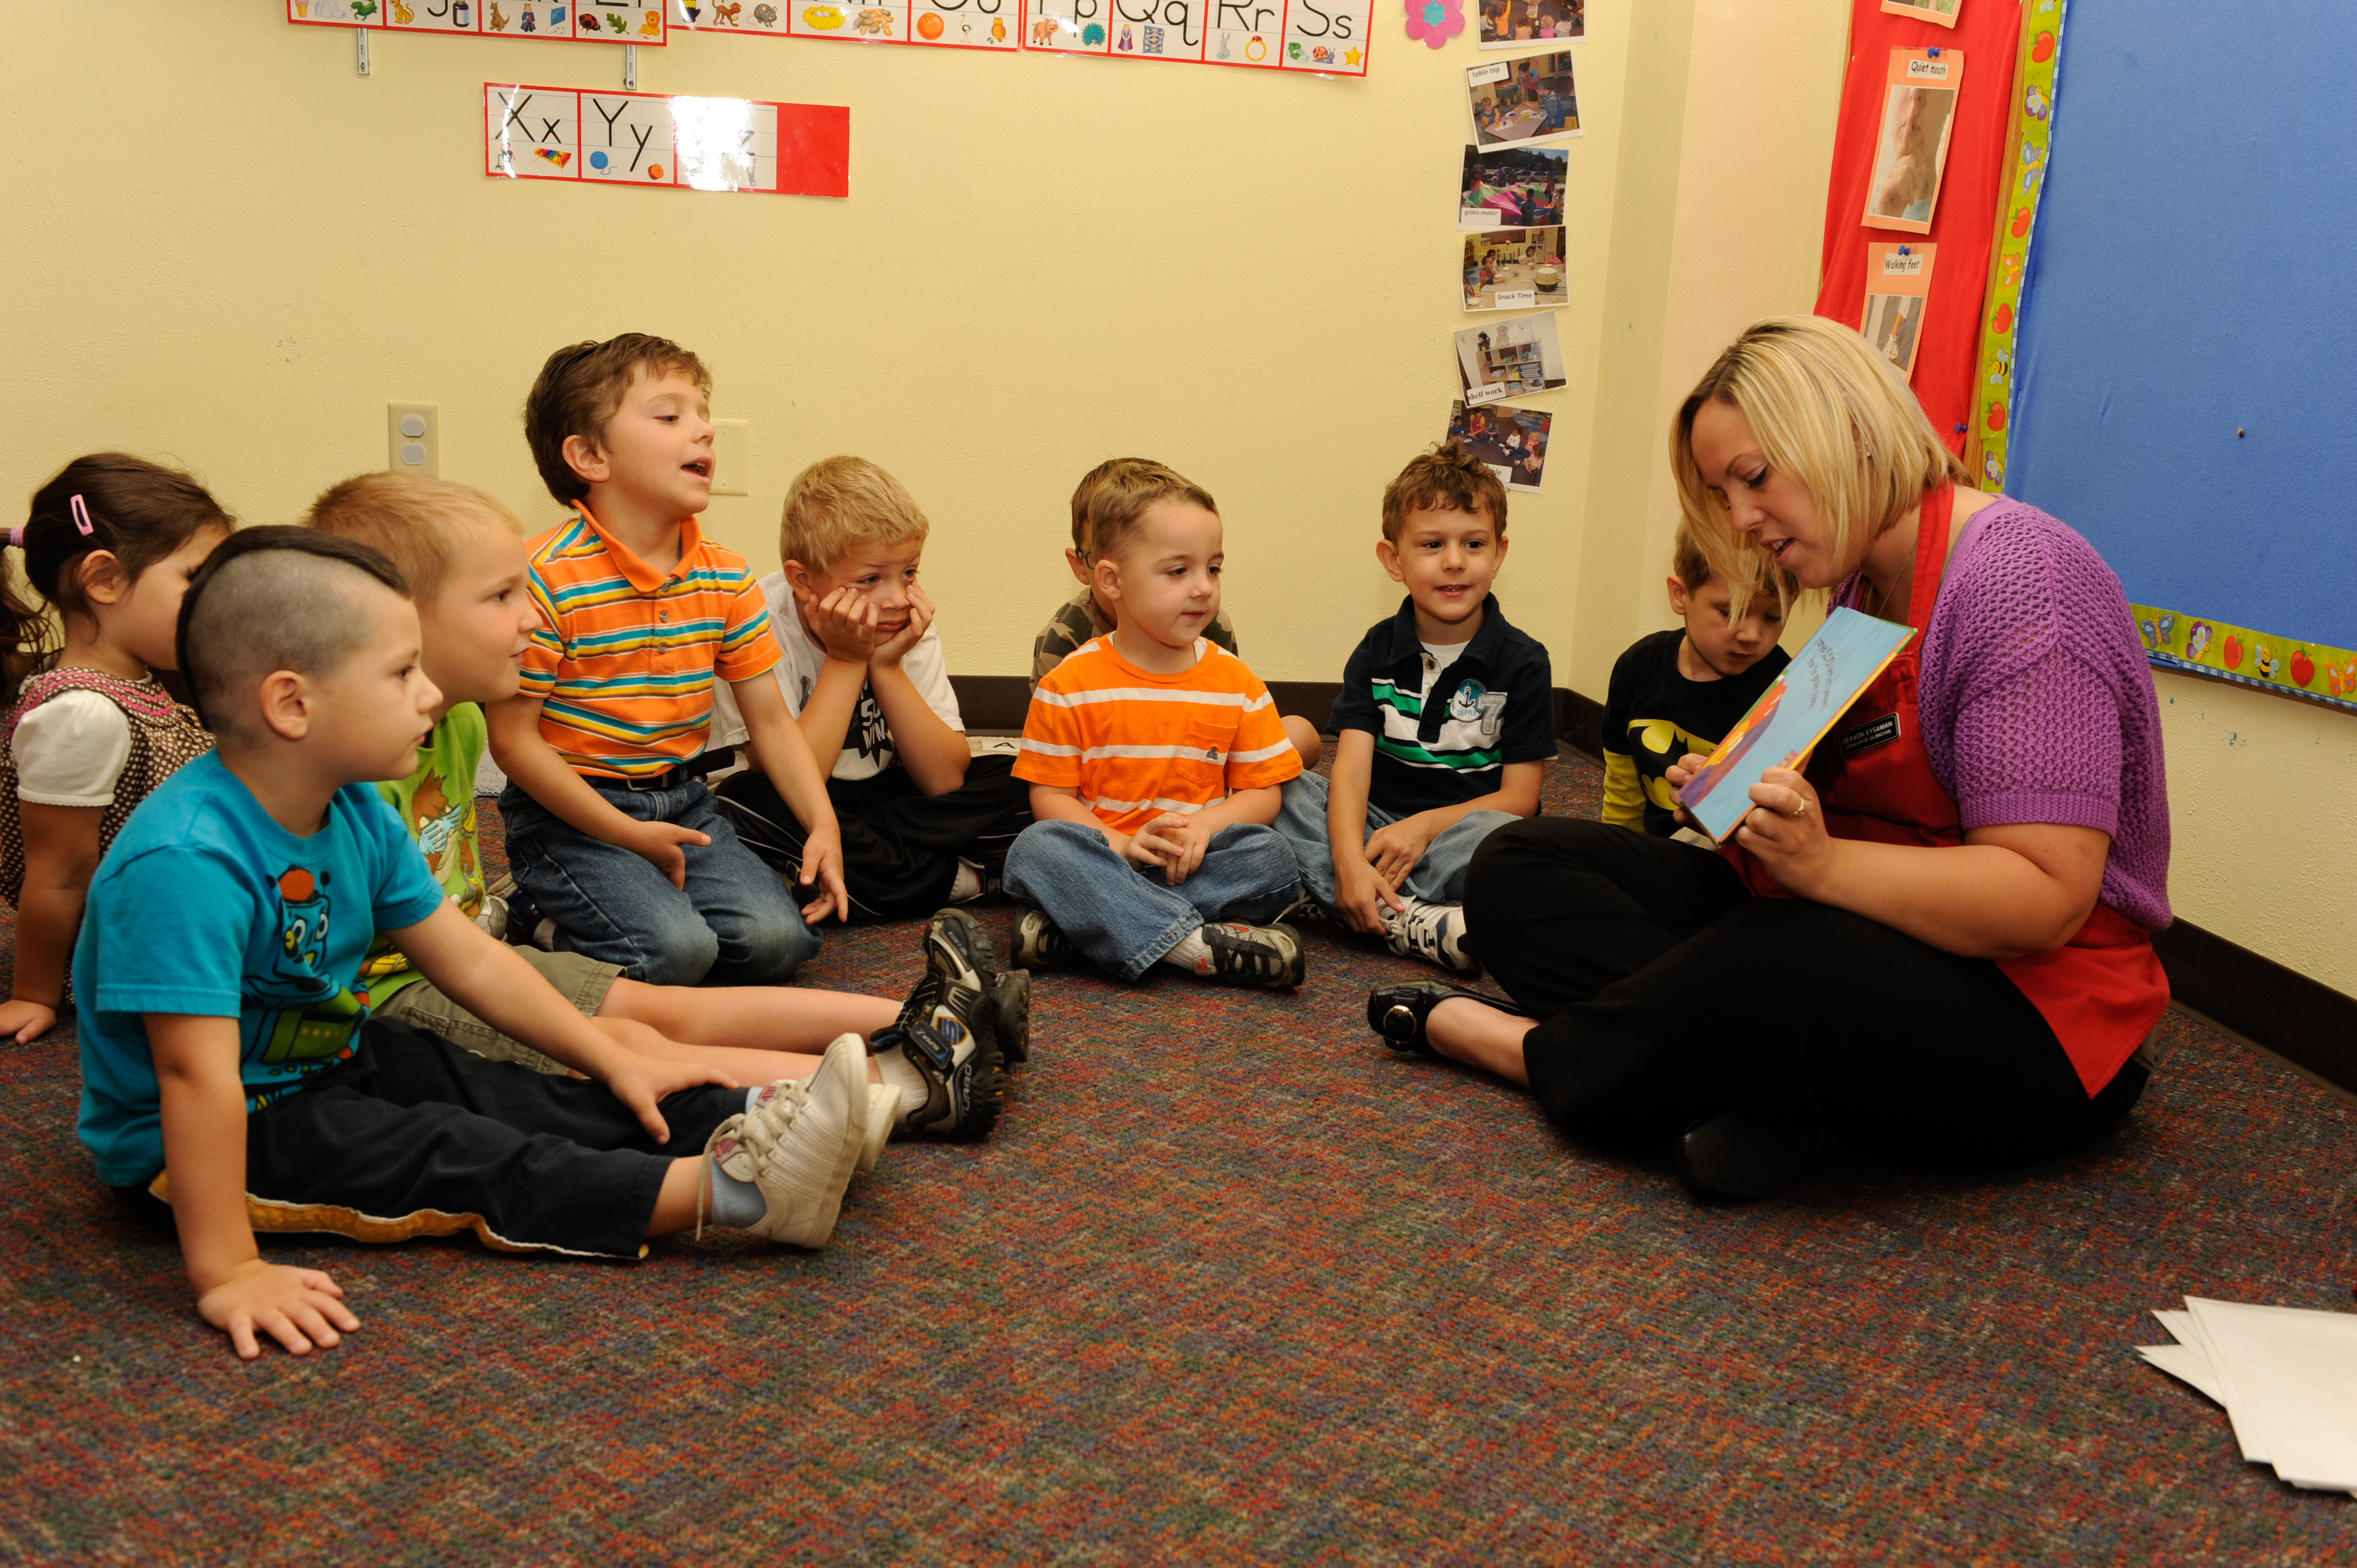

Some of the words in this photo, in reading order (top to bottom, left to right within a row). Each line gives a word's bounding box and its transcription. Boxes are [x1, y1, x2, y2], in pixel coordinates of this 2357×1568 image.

[1472, 69, 1489, 78] table
[1911, 61, 1929, 74] Quiet
[1930, 64, 1946, 75] mouth
[495, 91, 562, 144] Xx
[593, 98, 653, 172] Yy
[1885, 259, 1906, 272] Walking
[1907, 259, 1920, 270] feet
[1468, 390, 1484, 400] shelf
[1485, 387, 1504, 396] work
[1476, 693, 1506, 735] 7
[1842, 731, 1865, 745] DEAVON
[1865, 720, 1893, 736] EYSAMAN
[1869, 729, 1892, 741] CLINICIAN
[963, 1063, 972, 1120] TURBO
